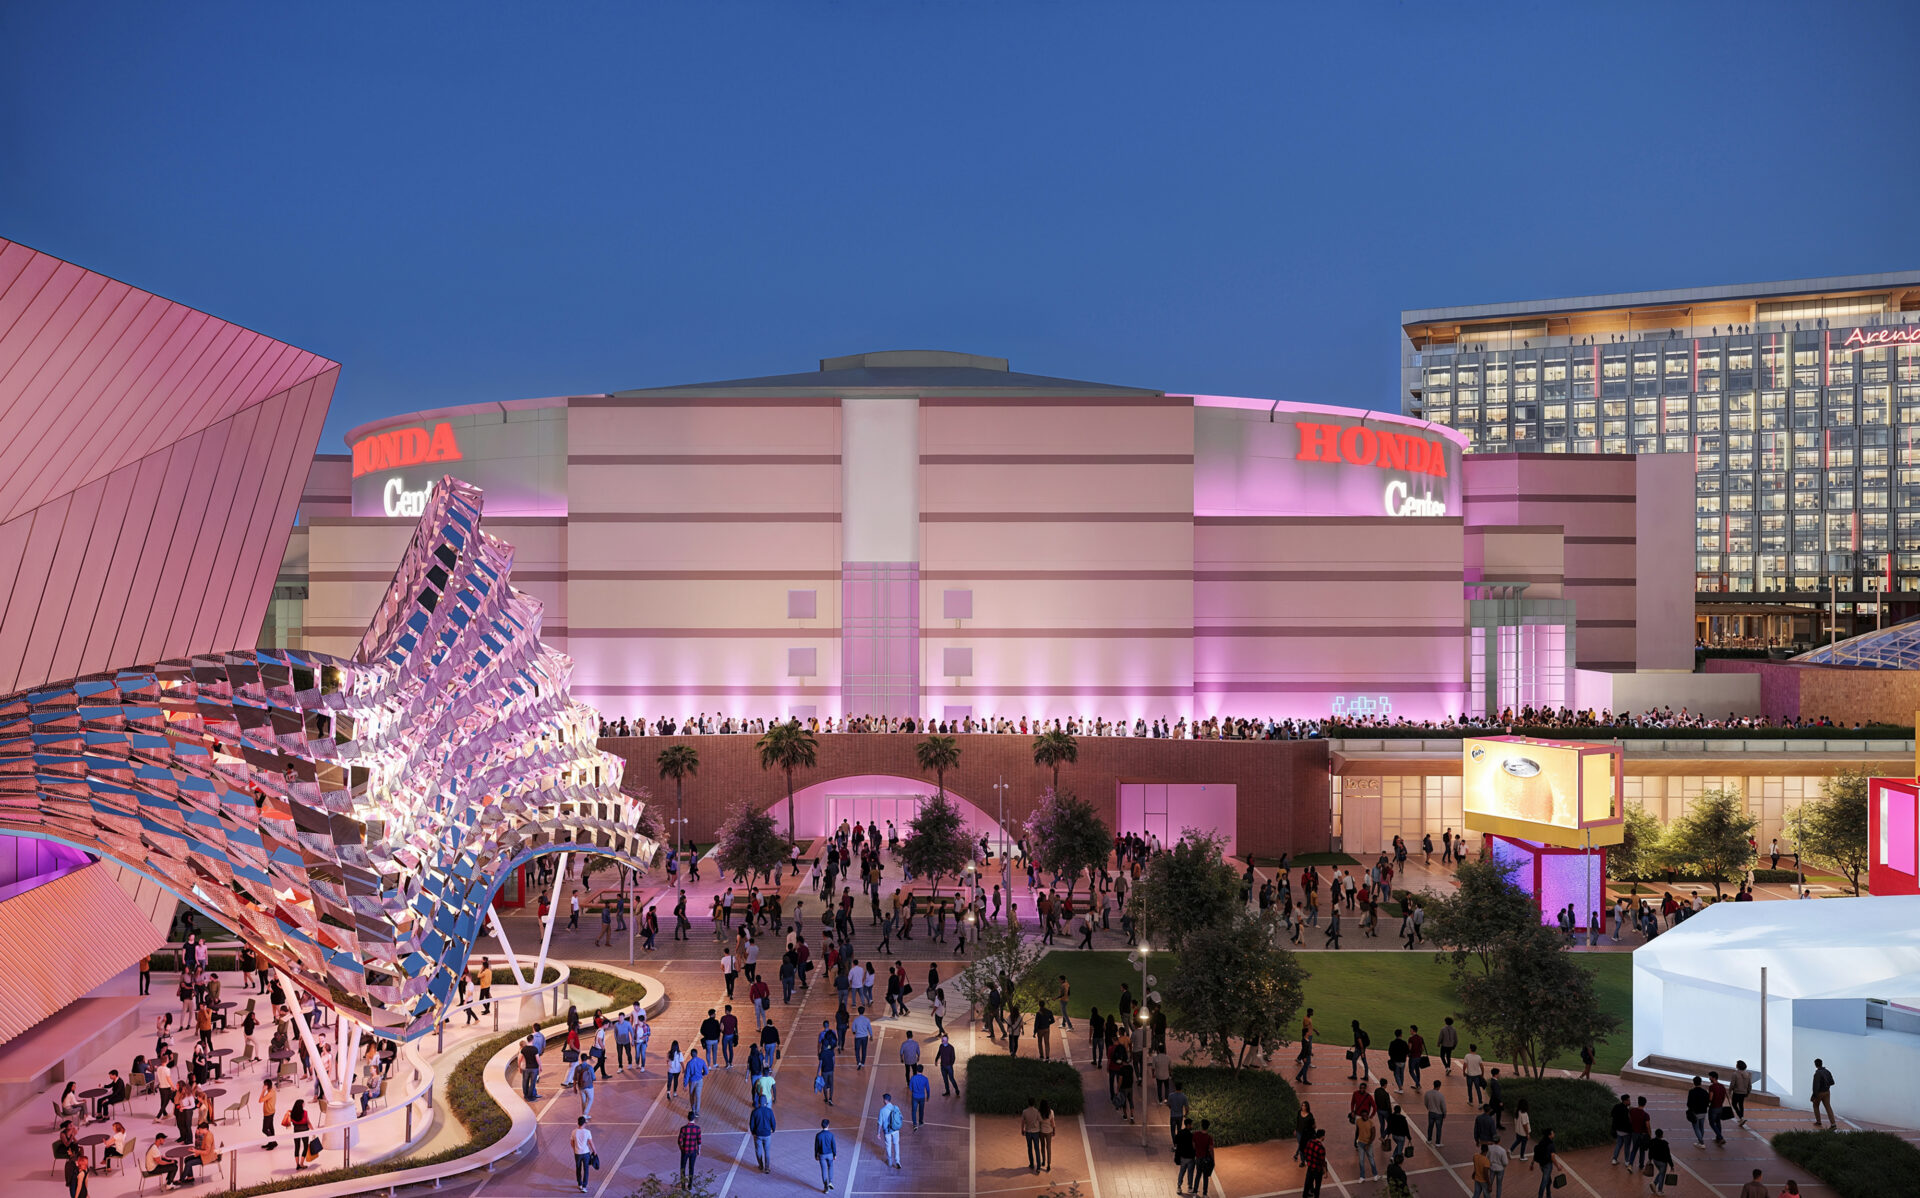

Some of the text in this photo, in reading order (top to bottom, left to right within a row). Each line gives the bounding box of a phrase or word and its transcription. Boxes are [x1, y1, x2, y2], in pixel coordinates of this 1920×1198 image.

[1295, 422, 1448, 478] HONDA
[383, 478, 435, 517] Cent
[1385, 480, 1446, 517] Center
